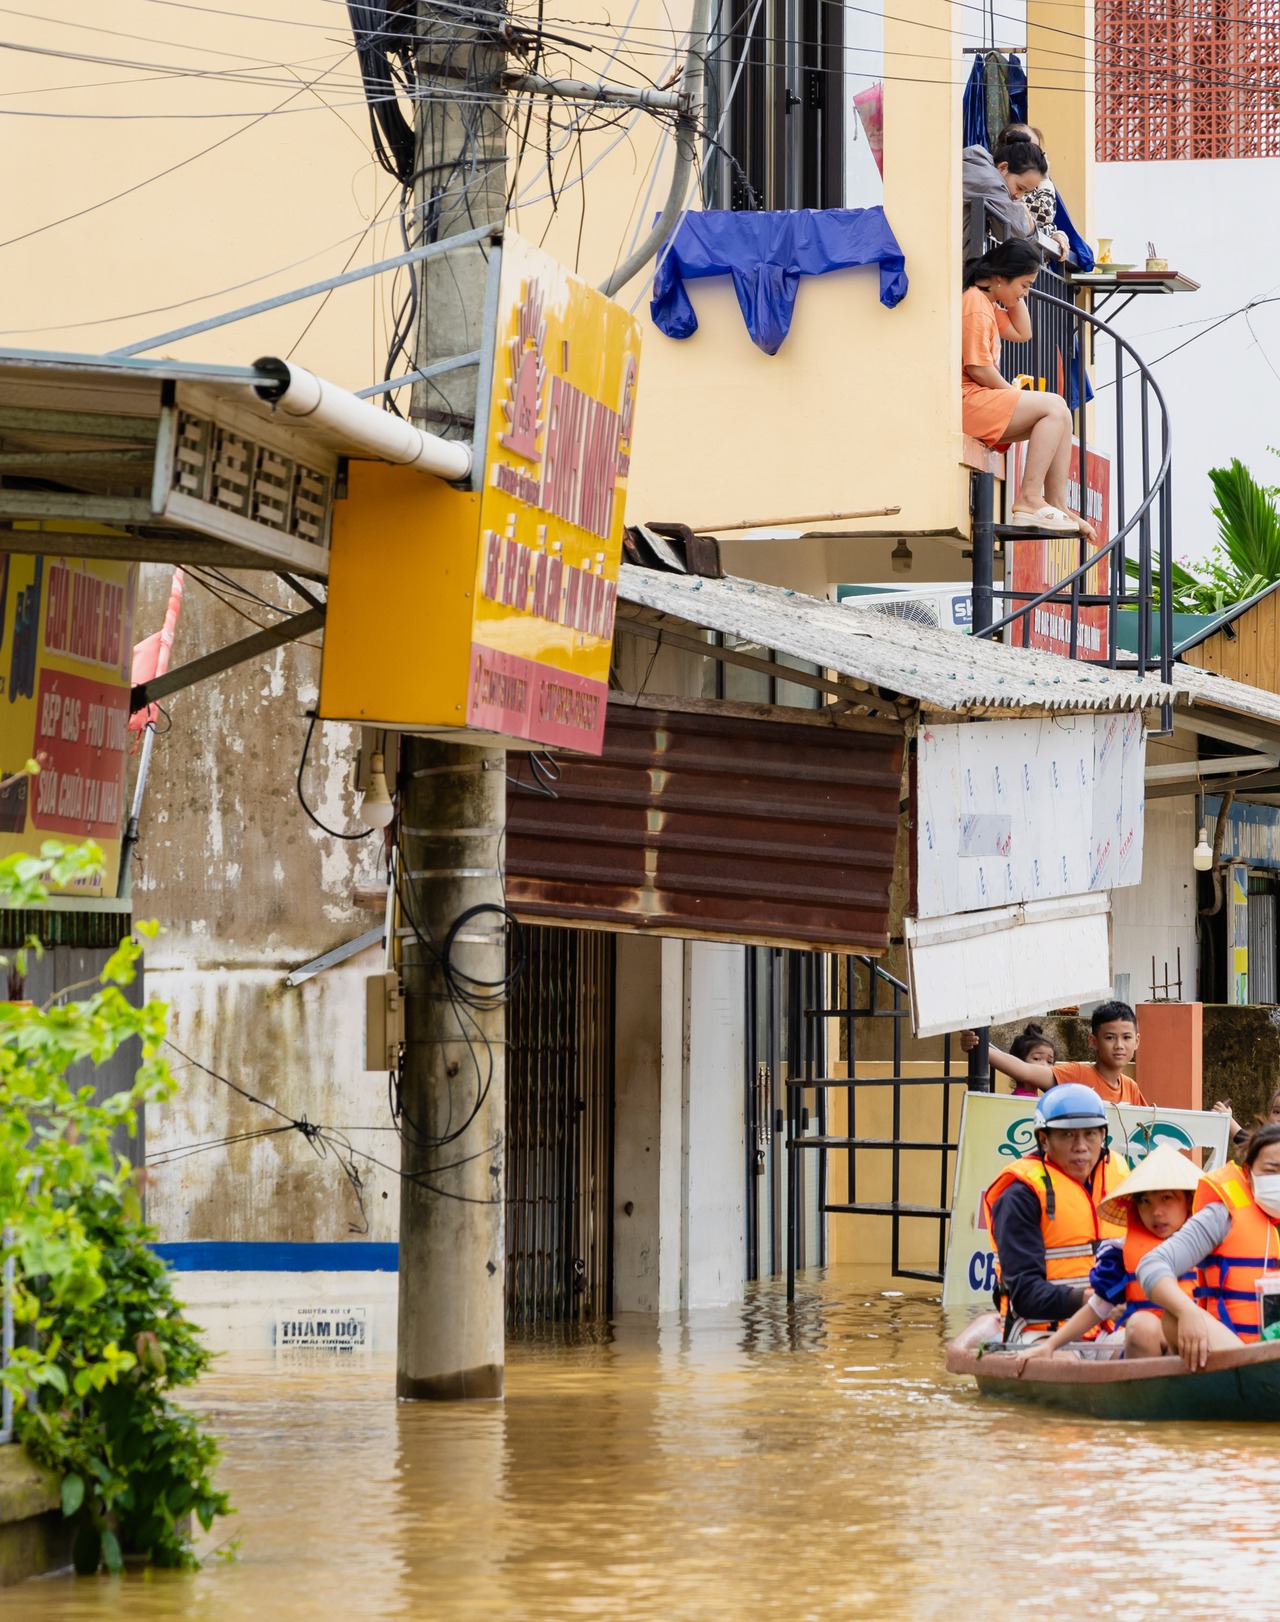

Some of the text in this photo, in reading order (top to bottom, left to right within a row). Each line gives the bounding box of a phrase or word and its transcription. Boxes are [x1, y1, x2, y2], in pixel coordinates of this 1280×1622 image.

[41, 680, 61, 737] BẾP
[61, 697, 82, 743] GAS
[84, 779, 101, 832] TẠI
